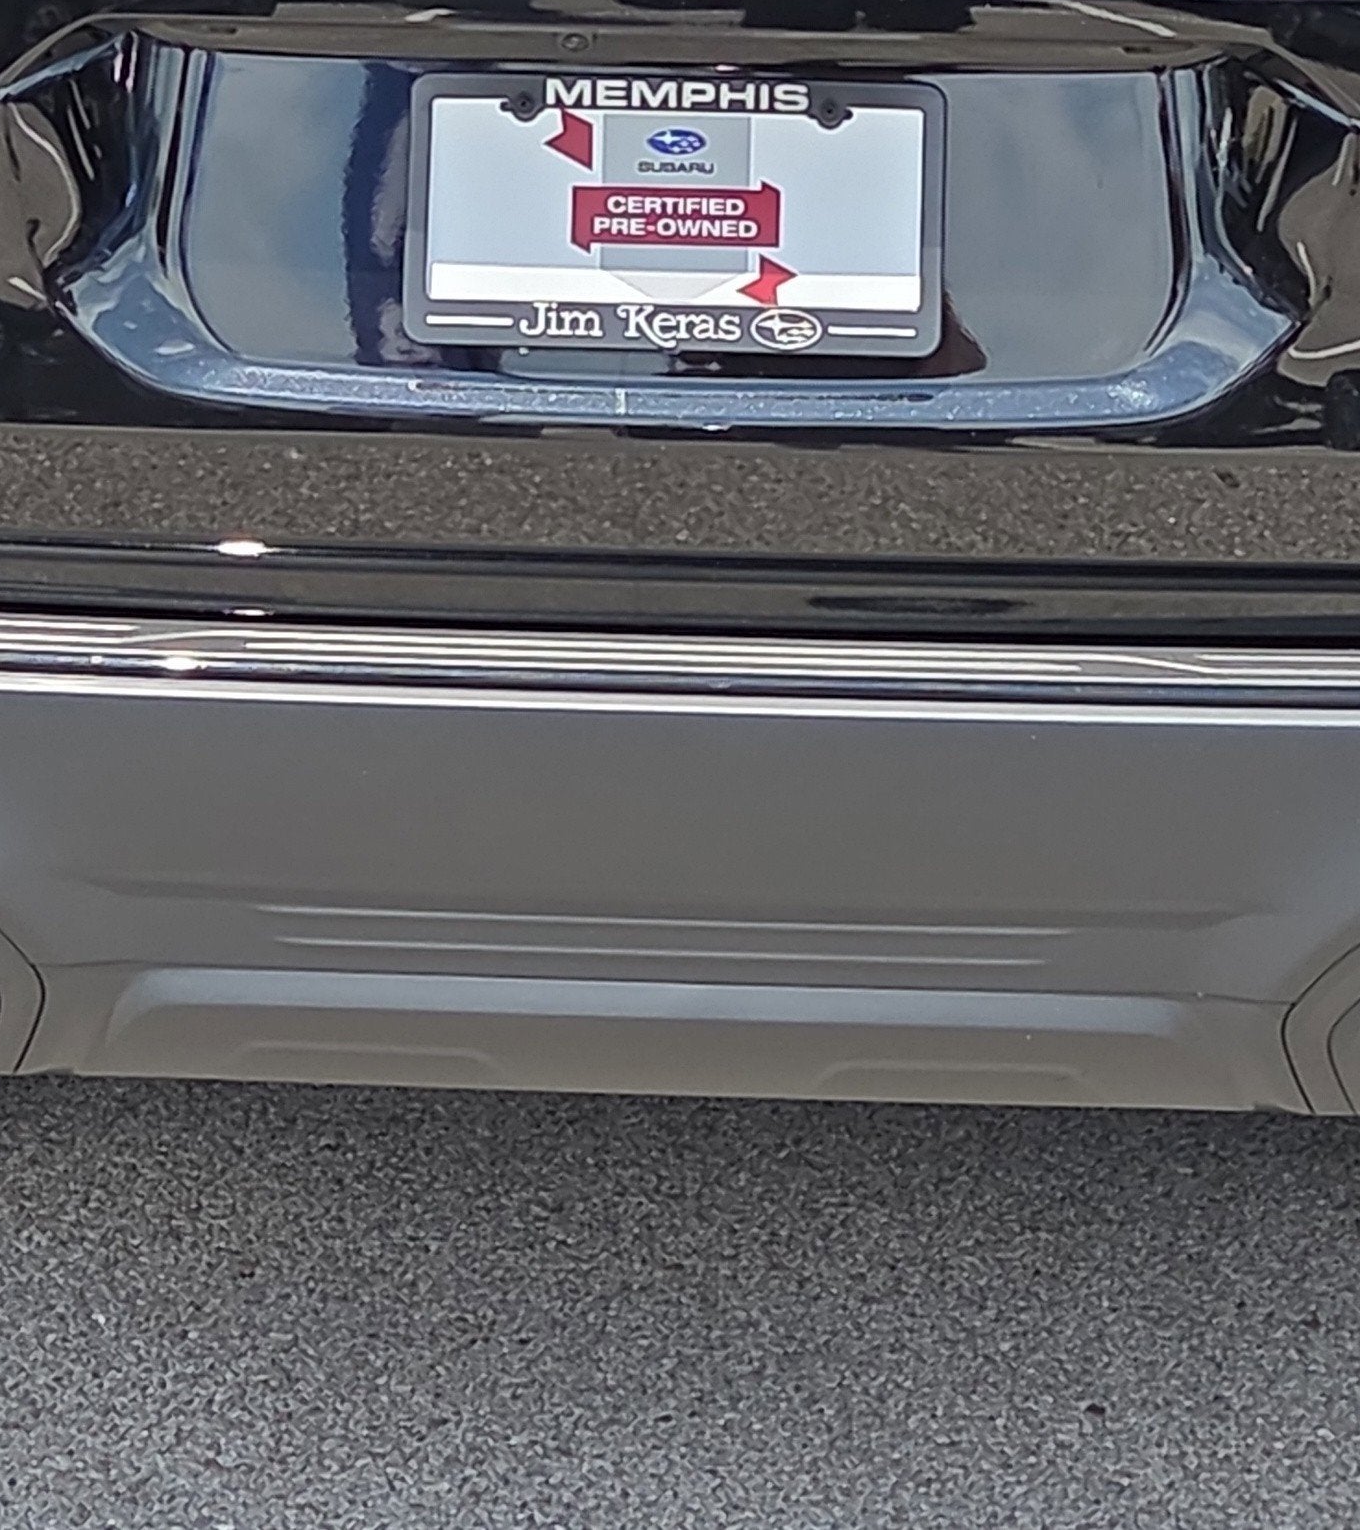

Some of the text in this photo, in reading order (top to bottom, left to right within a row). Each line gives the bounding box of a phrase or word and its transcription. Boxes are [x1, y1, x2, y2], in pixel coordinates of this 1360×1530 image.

[545, 78, 810, 112] MEMPHIS
[638, 161, 714, 174] SUBARU
[606, 195, 746, 216] CERTIFIED
[593, 217, 758, 239] PRE-OWNED
[519, 301, 742, 349] Jim Keras
